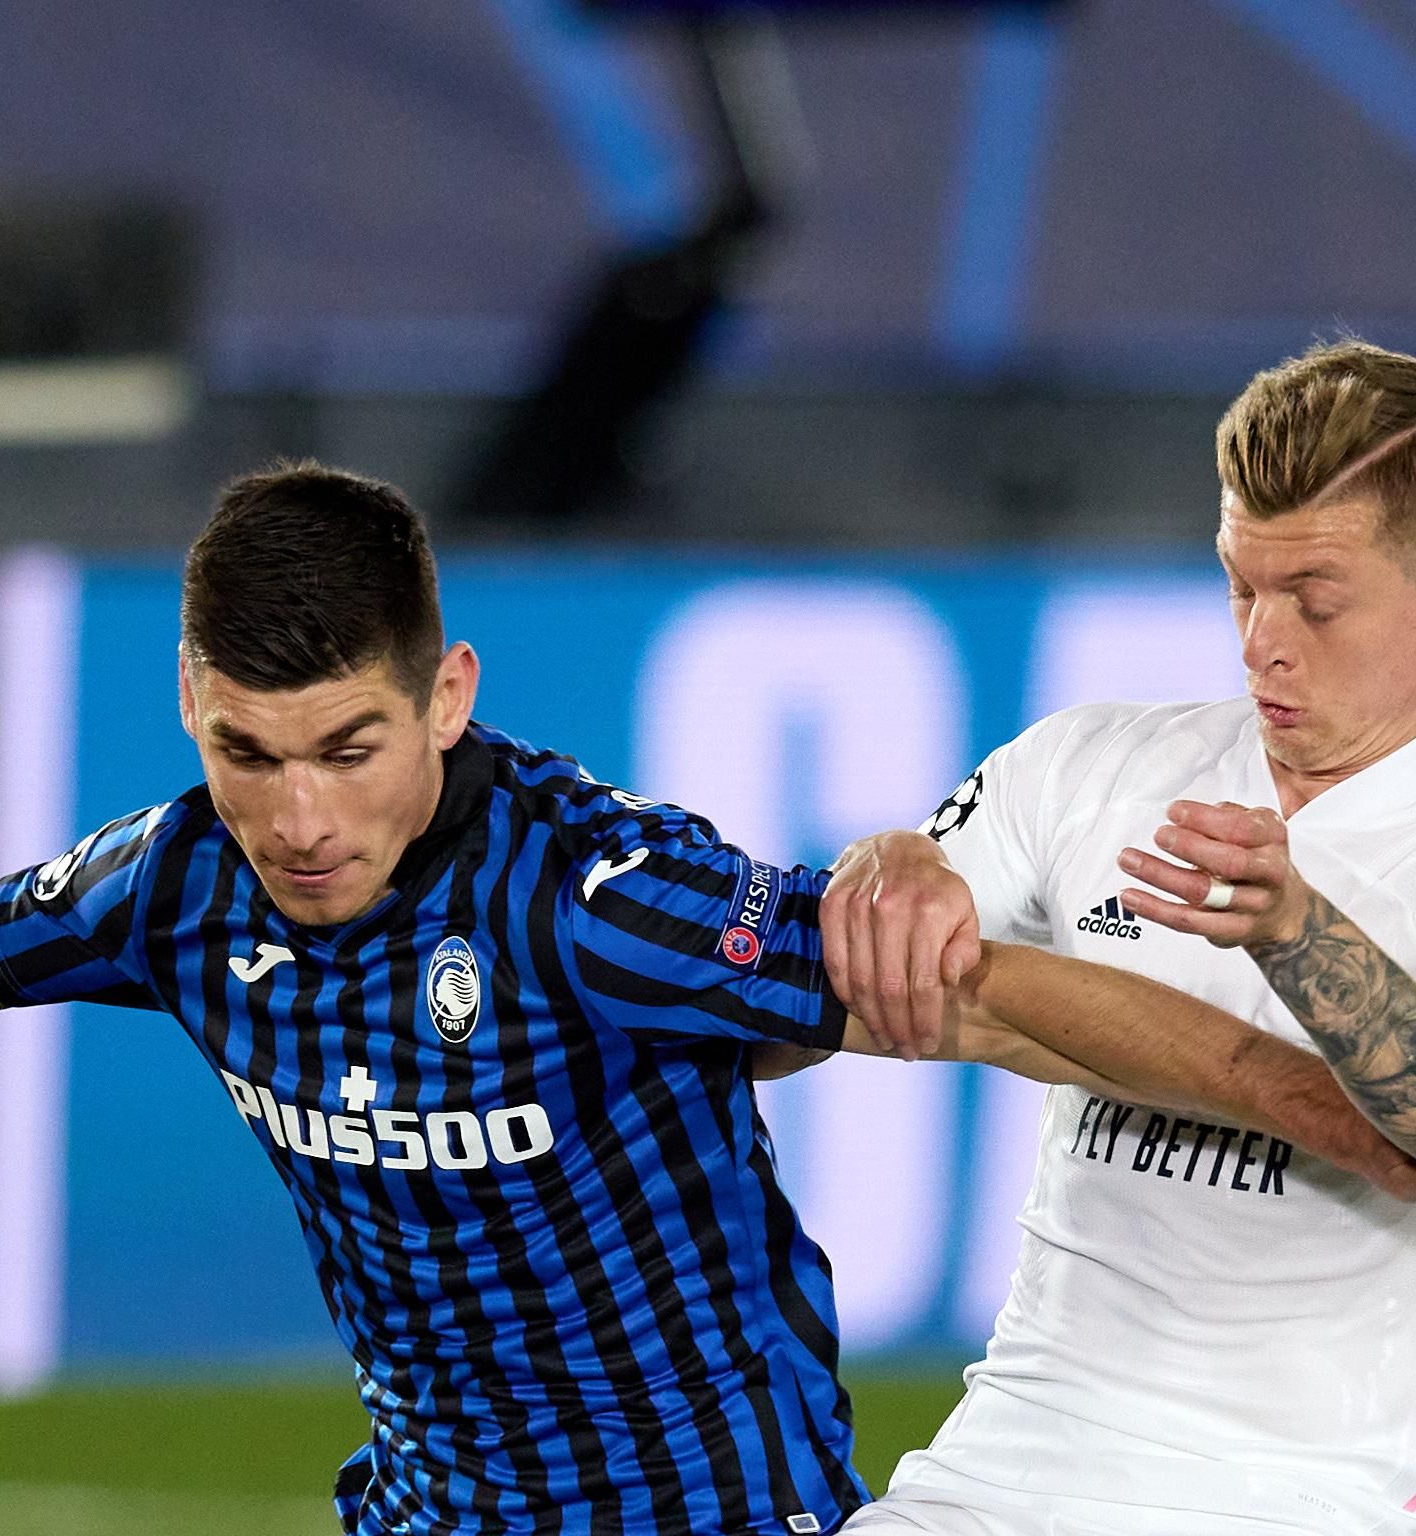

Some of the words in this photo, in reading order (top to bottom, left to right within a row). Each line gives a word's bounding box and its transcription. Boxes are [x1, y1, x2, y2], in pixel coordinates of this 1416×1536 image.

[1077, 914, 1142, 940] adidas
[435, 948, 472, 964] ATALANTA
[441, 1018, 466, 1031] 1907
[1070, 1096, 1135, 1164] FLY
[1131, 1112, 1294, 1196] BETTER
